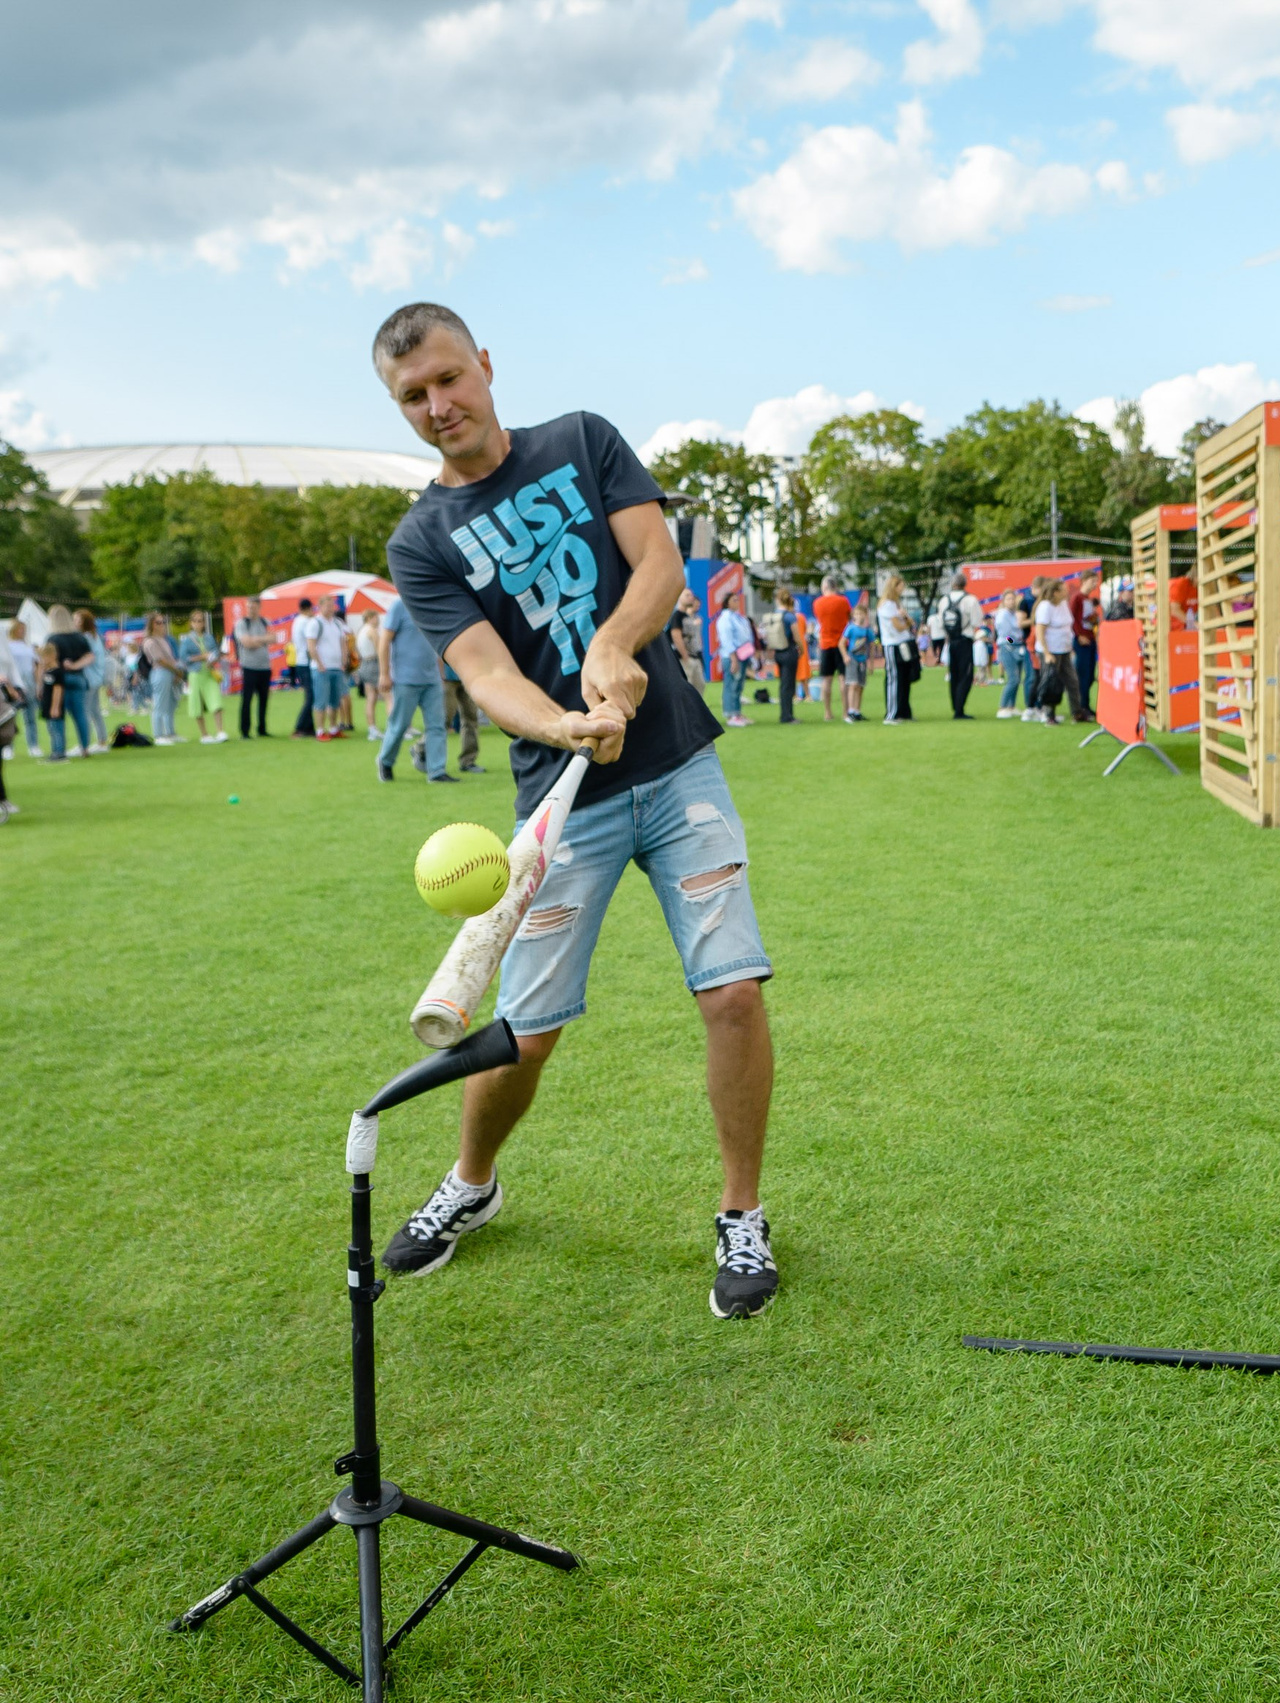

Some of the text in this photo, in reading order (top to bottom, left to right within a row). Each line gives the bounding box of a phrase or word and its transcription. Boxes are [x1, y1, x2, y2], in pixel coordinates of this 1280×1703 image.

[450, 462, 594, 592] JUST
[509, 532, 598, 631] DO
[549, 592, 598, 677] IT
